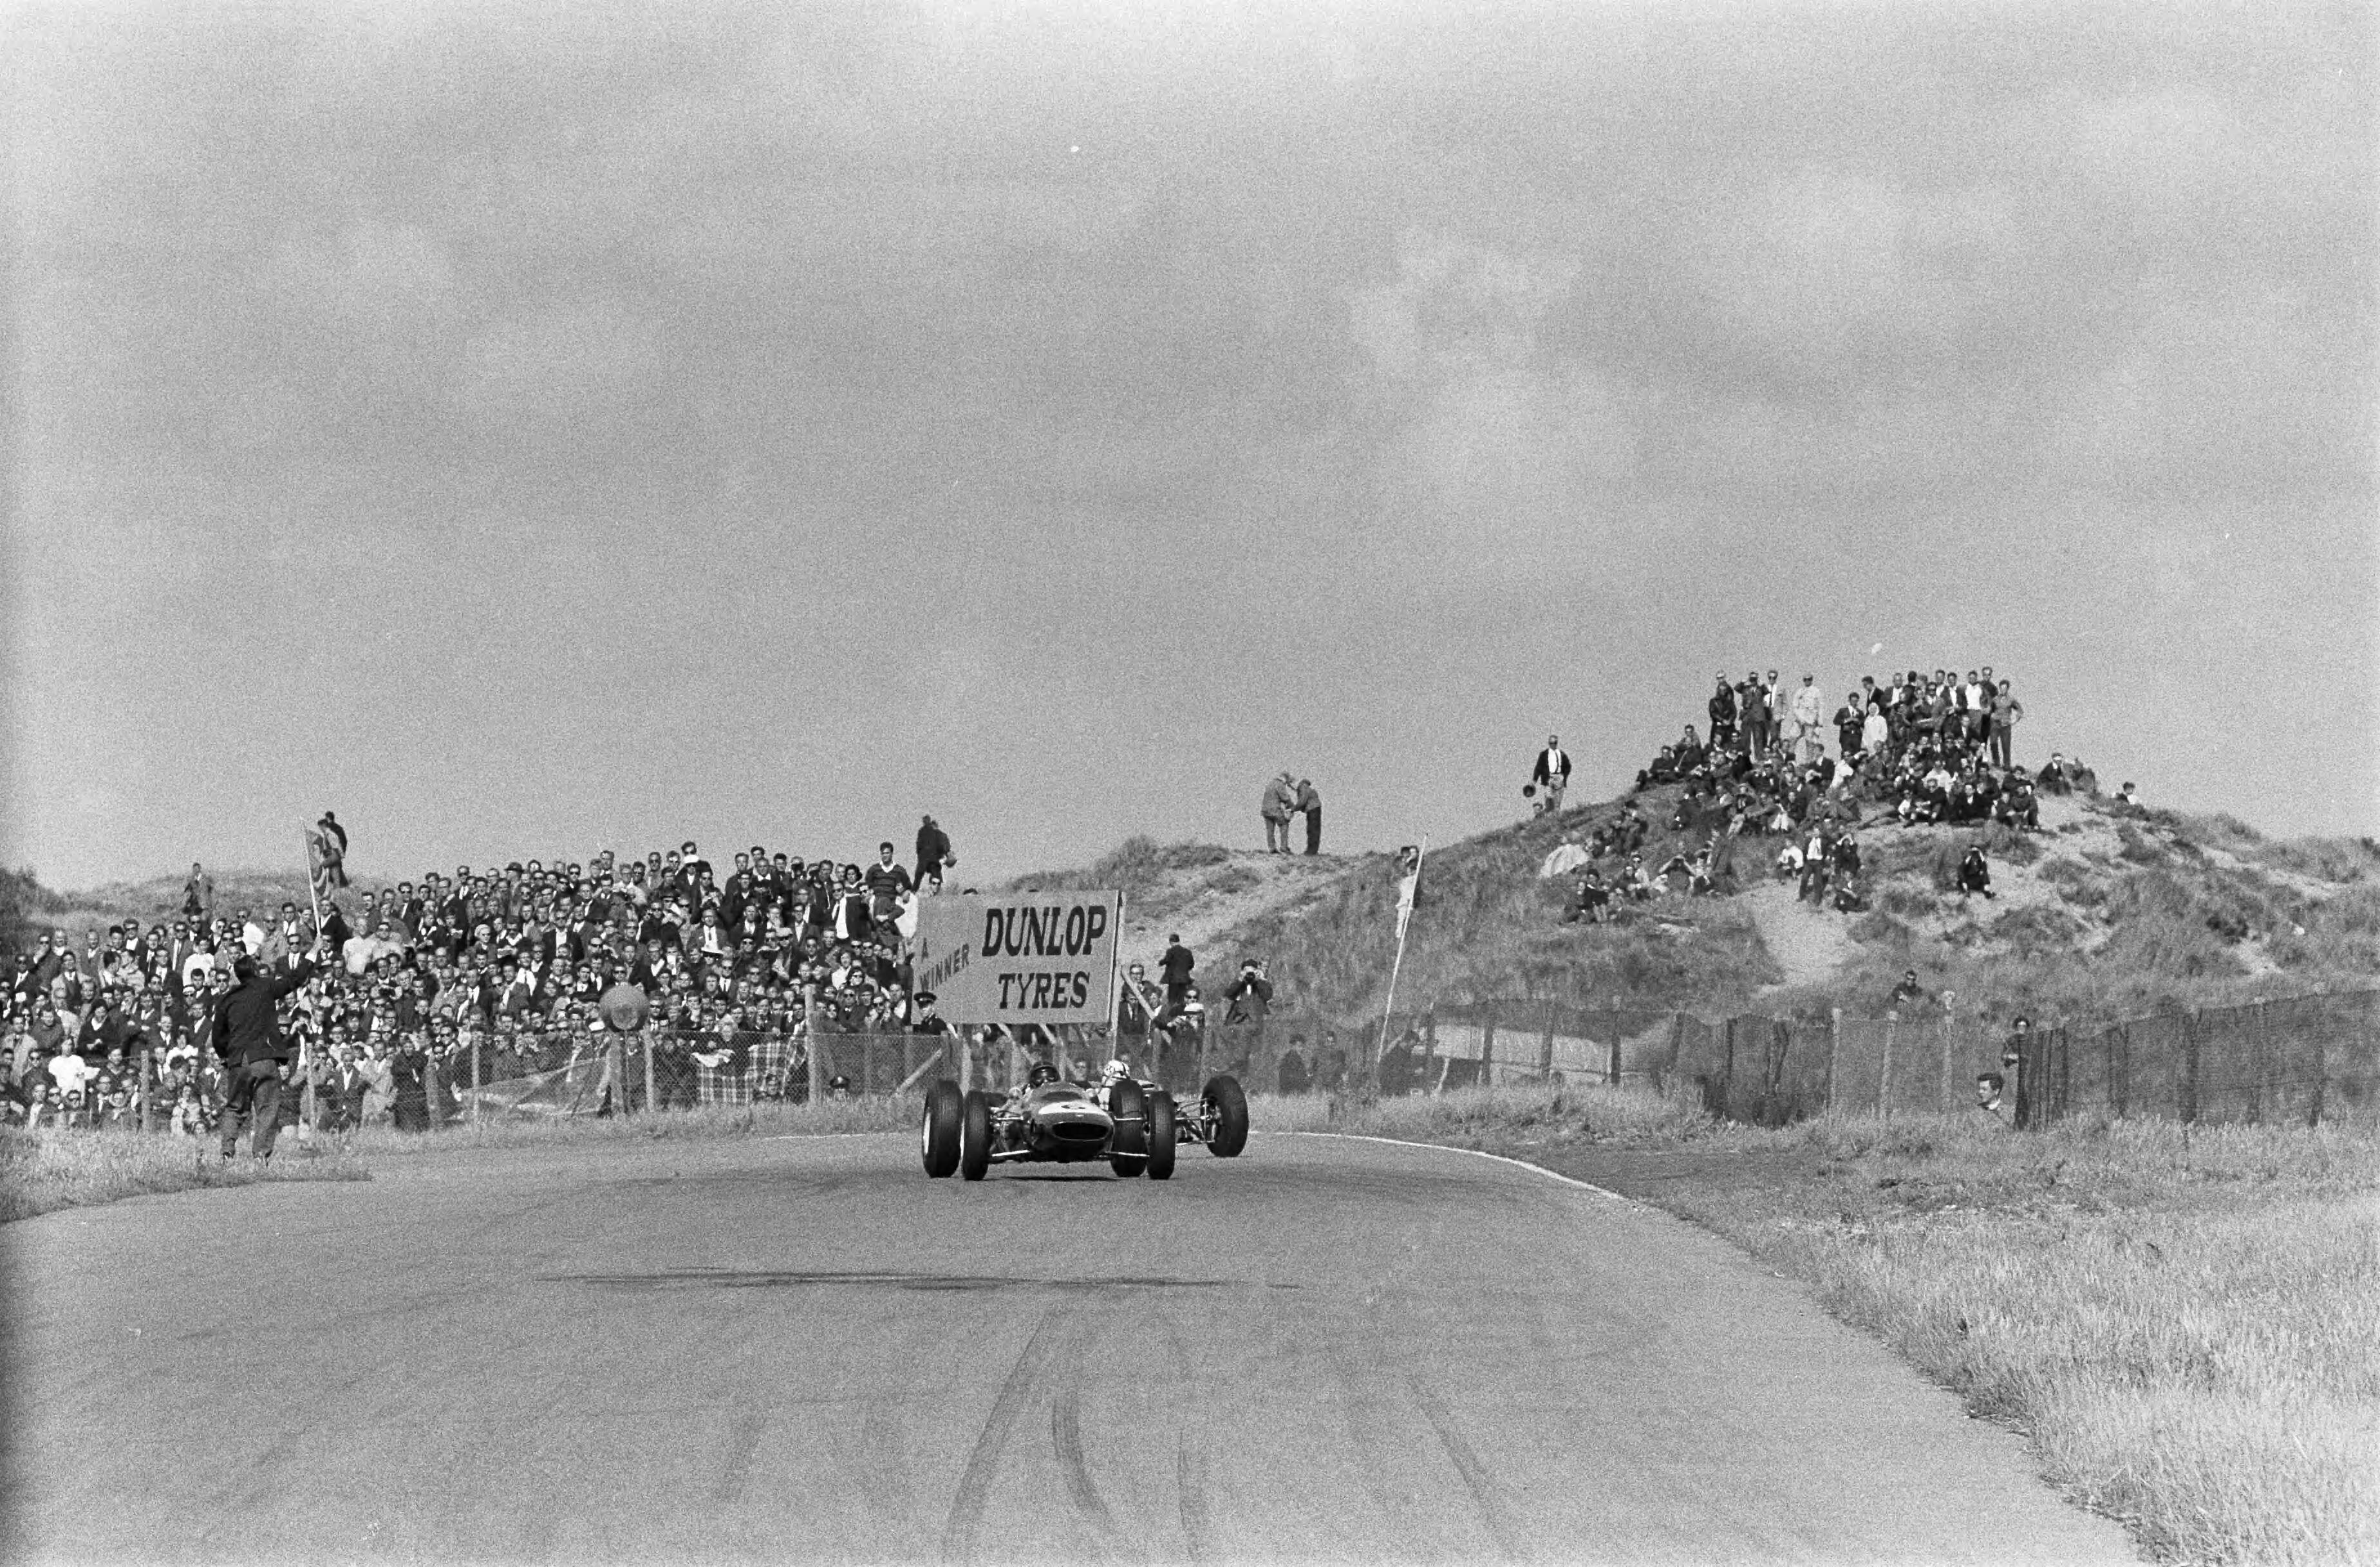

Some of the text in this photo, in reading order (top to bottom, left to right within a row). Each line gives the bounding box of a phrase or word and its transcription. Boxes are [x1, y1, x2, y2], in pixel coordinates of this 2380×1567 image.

[921, 937, 928, 964] A
[982, 905, 1107, 957] DUNLOP
[919, 944, 970, 992] WINNER
[998, 971, 1091, 1009] TYRES
